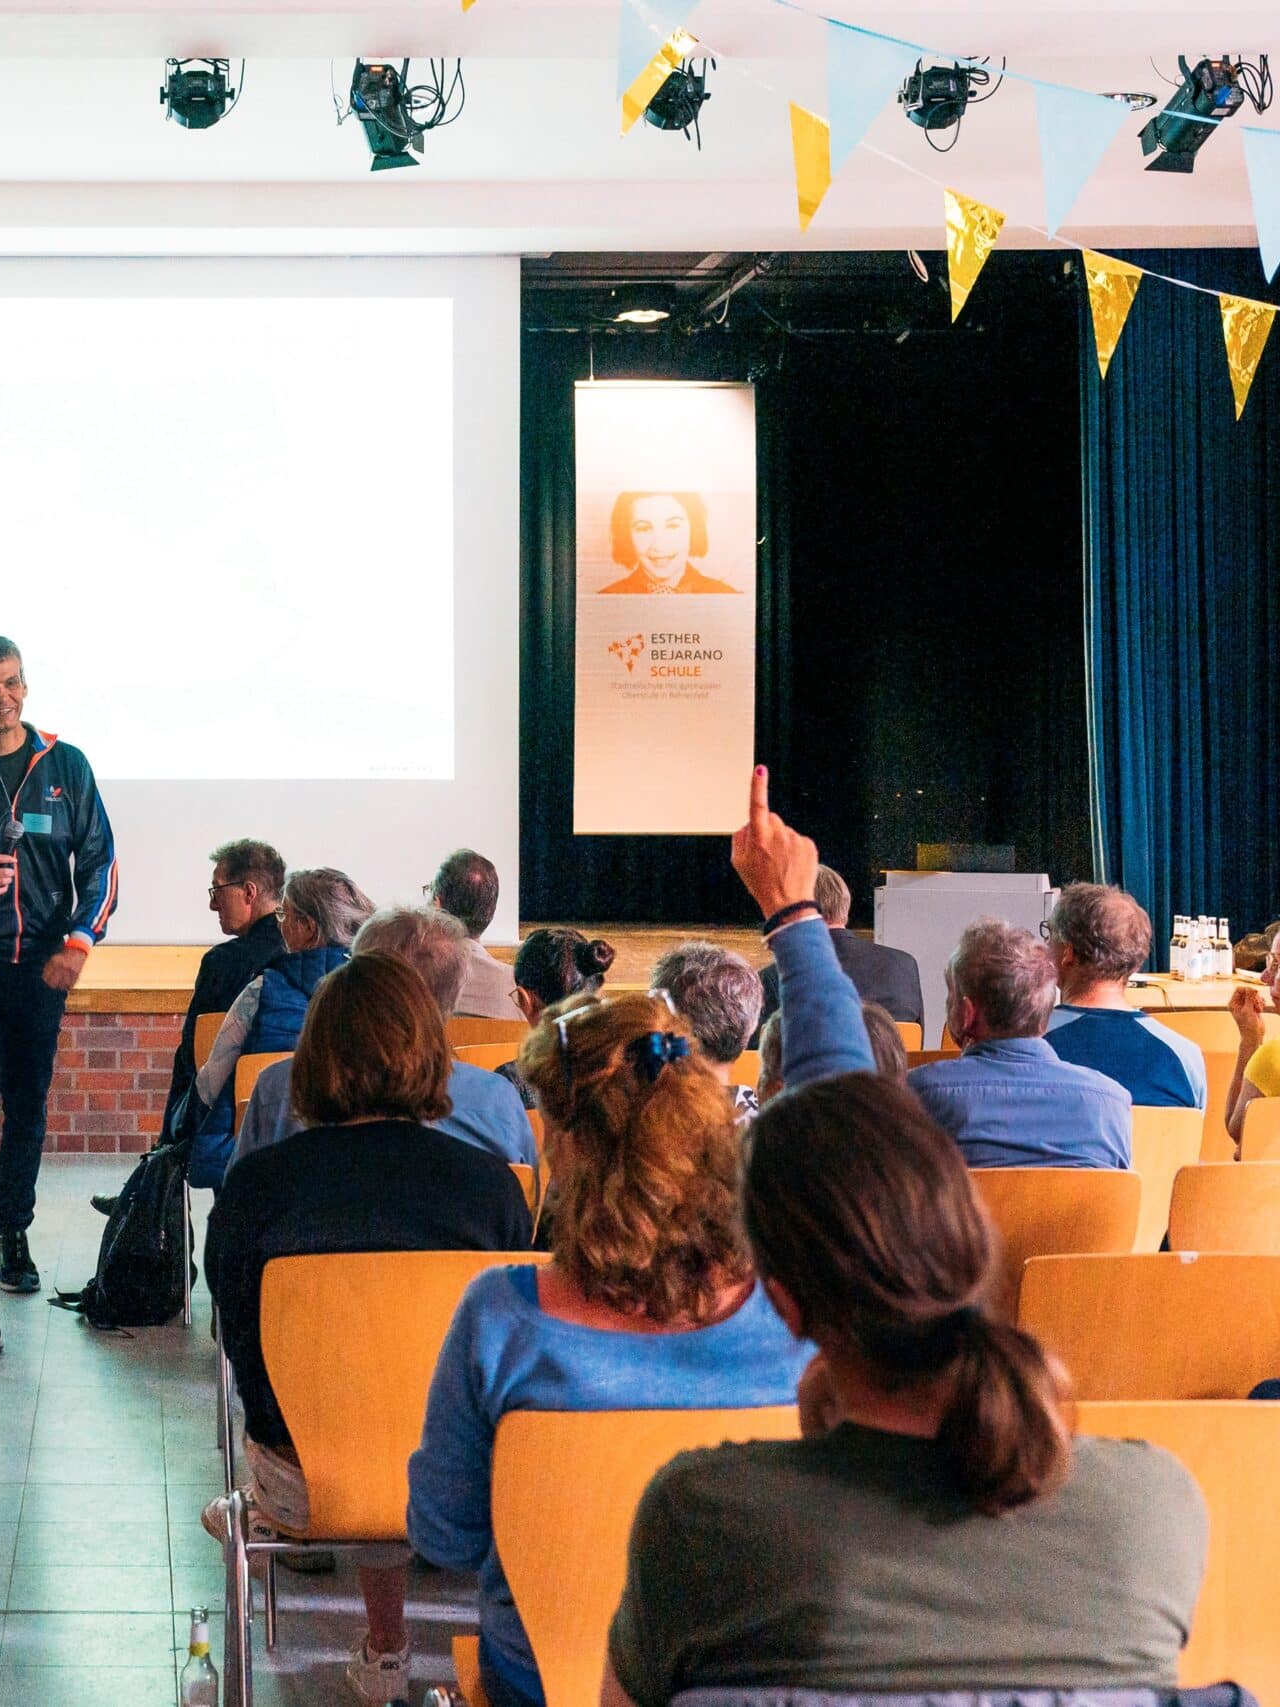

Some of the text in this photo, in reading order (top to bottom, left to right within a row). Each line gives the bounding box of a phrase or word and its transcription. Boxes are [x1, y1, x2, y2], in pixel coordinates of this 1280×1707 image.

[650, 633, 701, 645] ESTHER
[650, 649, 723, 661] BEJARANO
[650, 665, 701, 677] SCHULE
